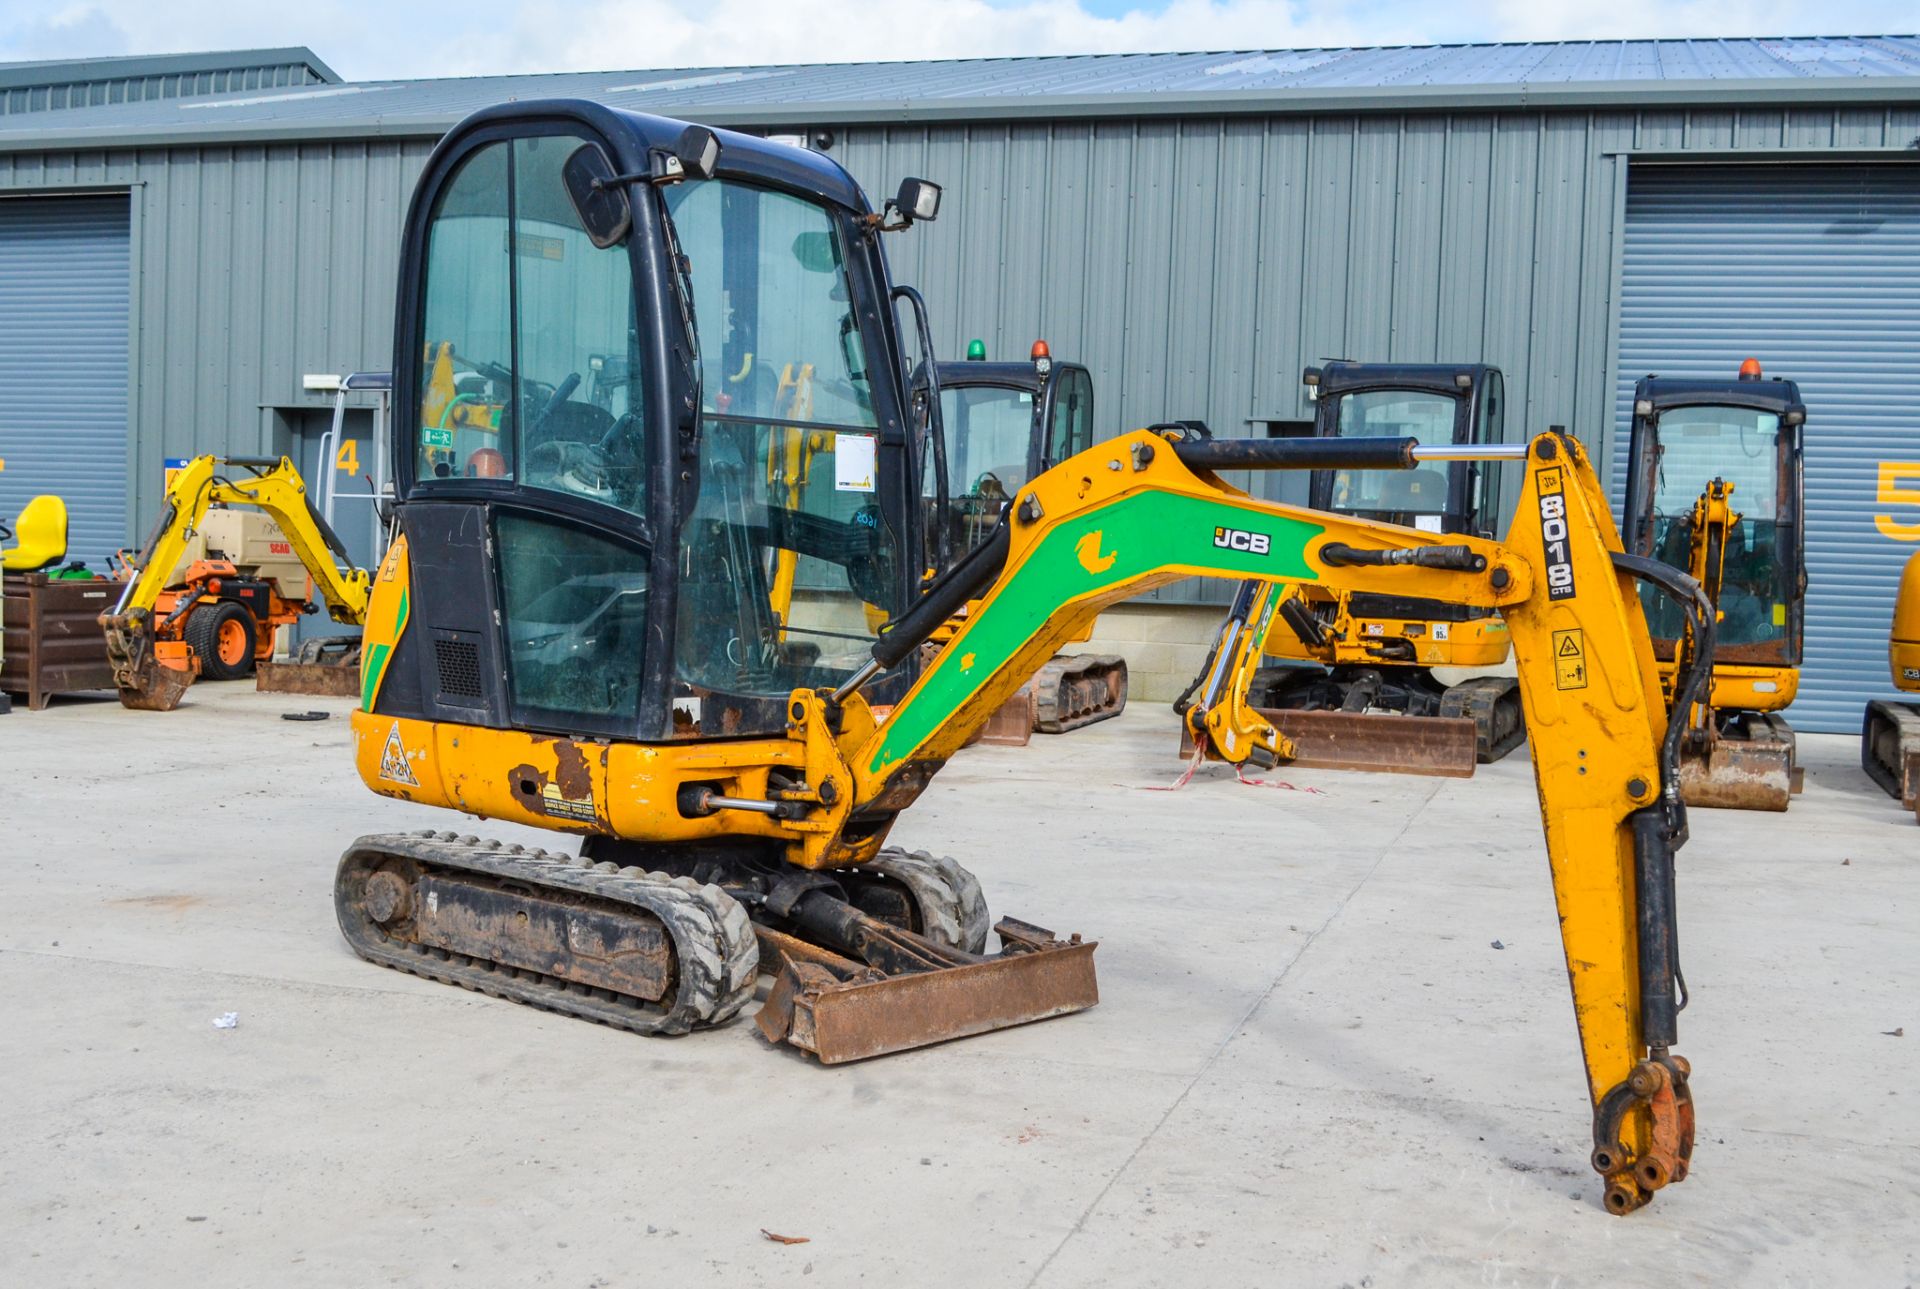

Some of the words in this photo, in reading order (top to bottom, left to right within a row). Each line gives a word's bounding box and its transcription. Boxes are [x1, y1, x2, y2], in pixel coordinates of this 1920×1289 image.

[336, 439, 359, 476] 4
[1874, 462, 1920, 541] 5
[1214, 528, 1269, 554] JCB
[1540, 495, 1572, 587] 8018
